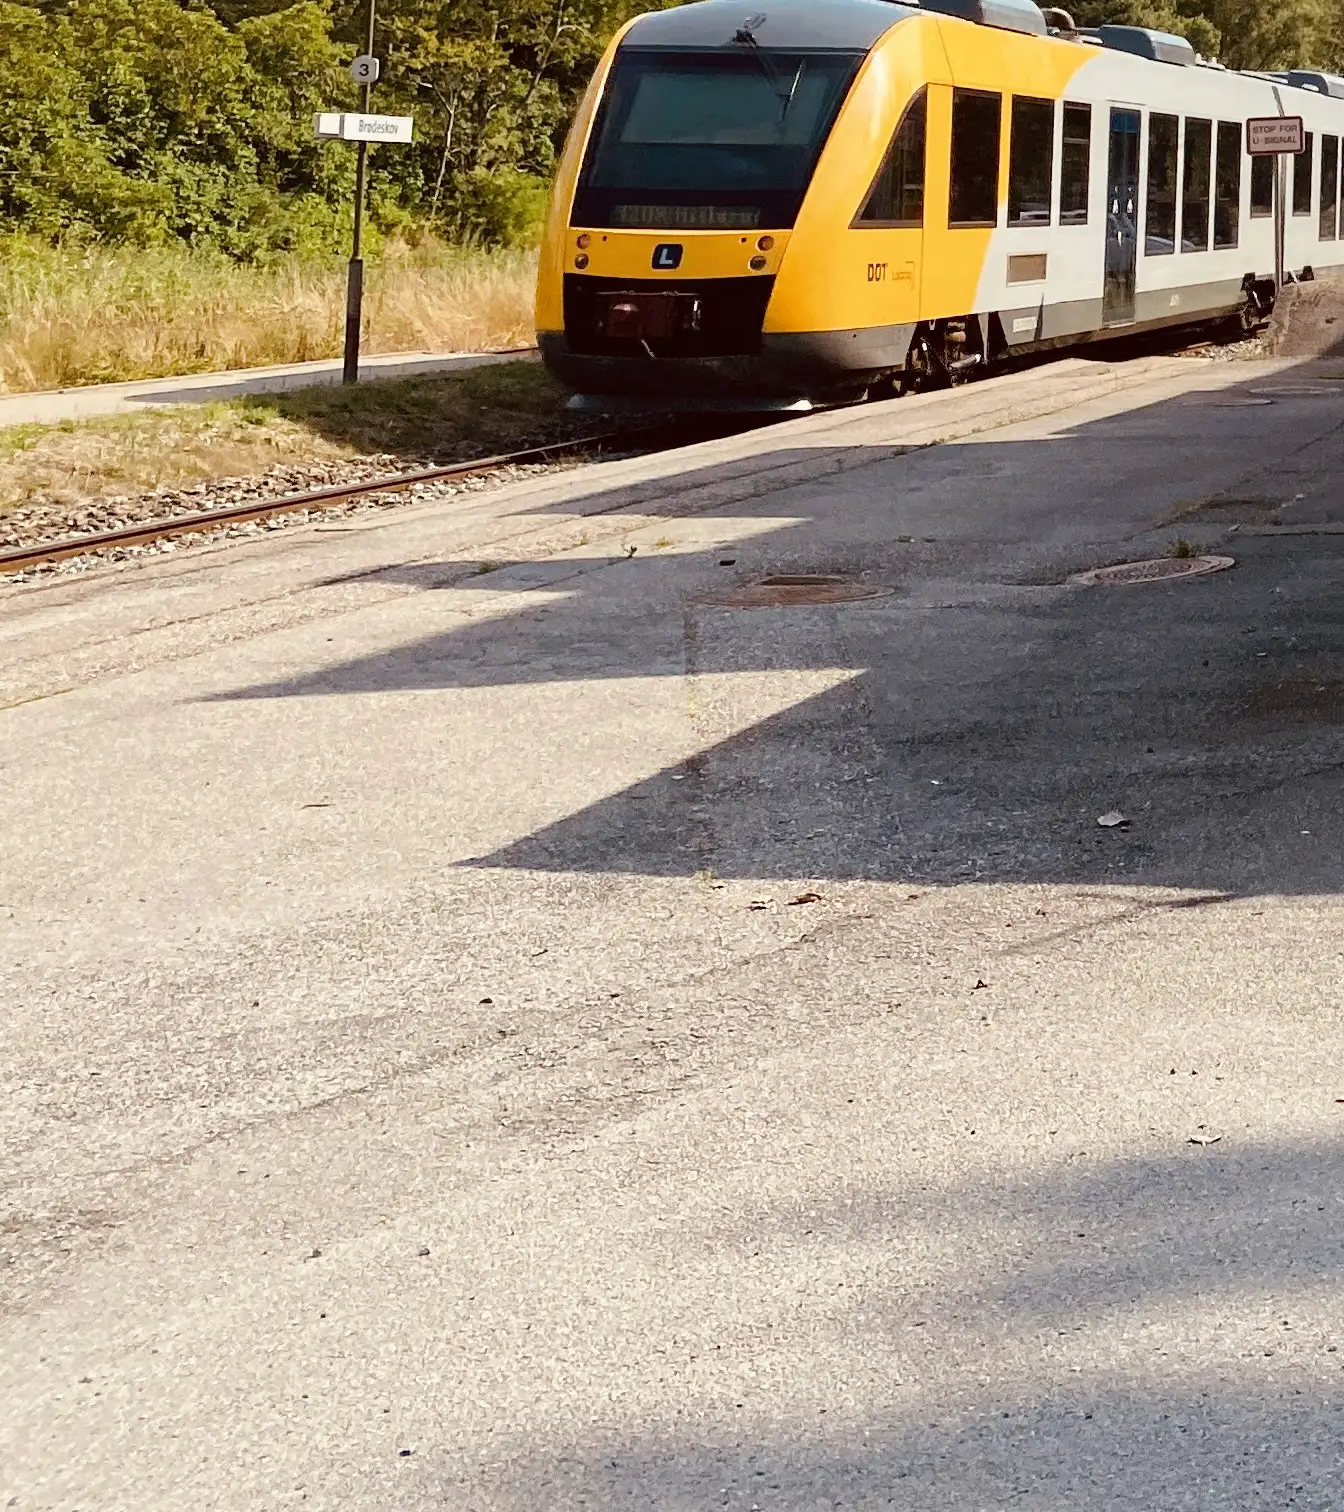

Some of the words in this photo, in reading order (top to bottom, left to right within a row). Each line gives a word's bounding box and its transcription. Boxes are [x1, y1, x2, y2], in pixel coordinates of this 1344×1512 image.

[359, 63, 369, 76] 3
[1252, 125, 1277, 134] STOP
[1279, 124, 1298, 133] FOR
[659, 248, 673, 265] L
[867, 262, 888, 282] DOT
